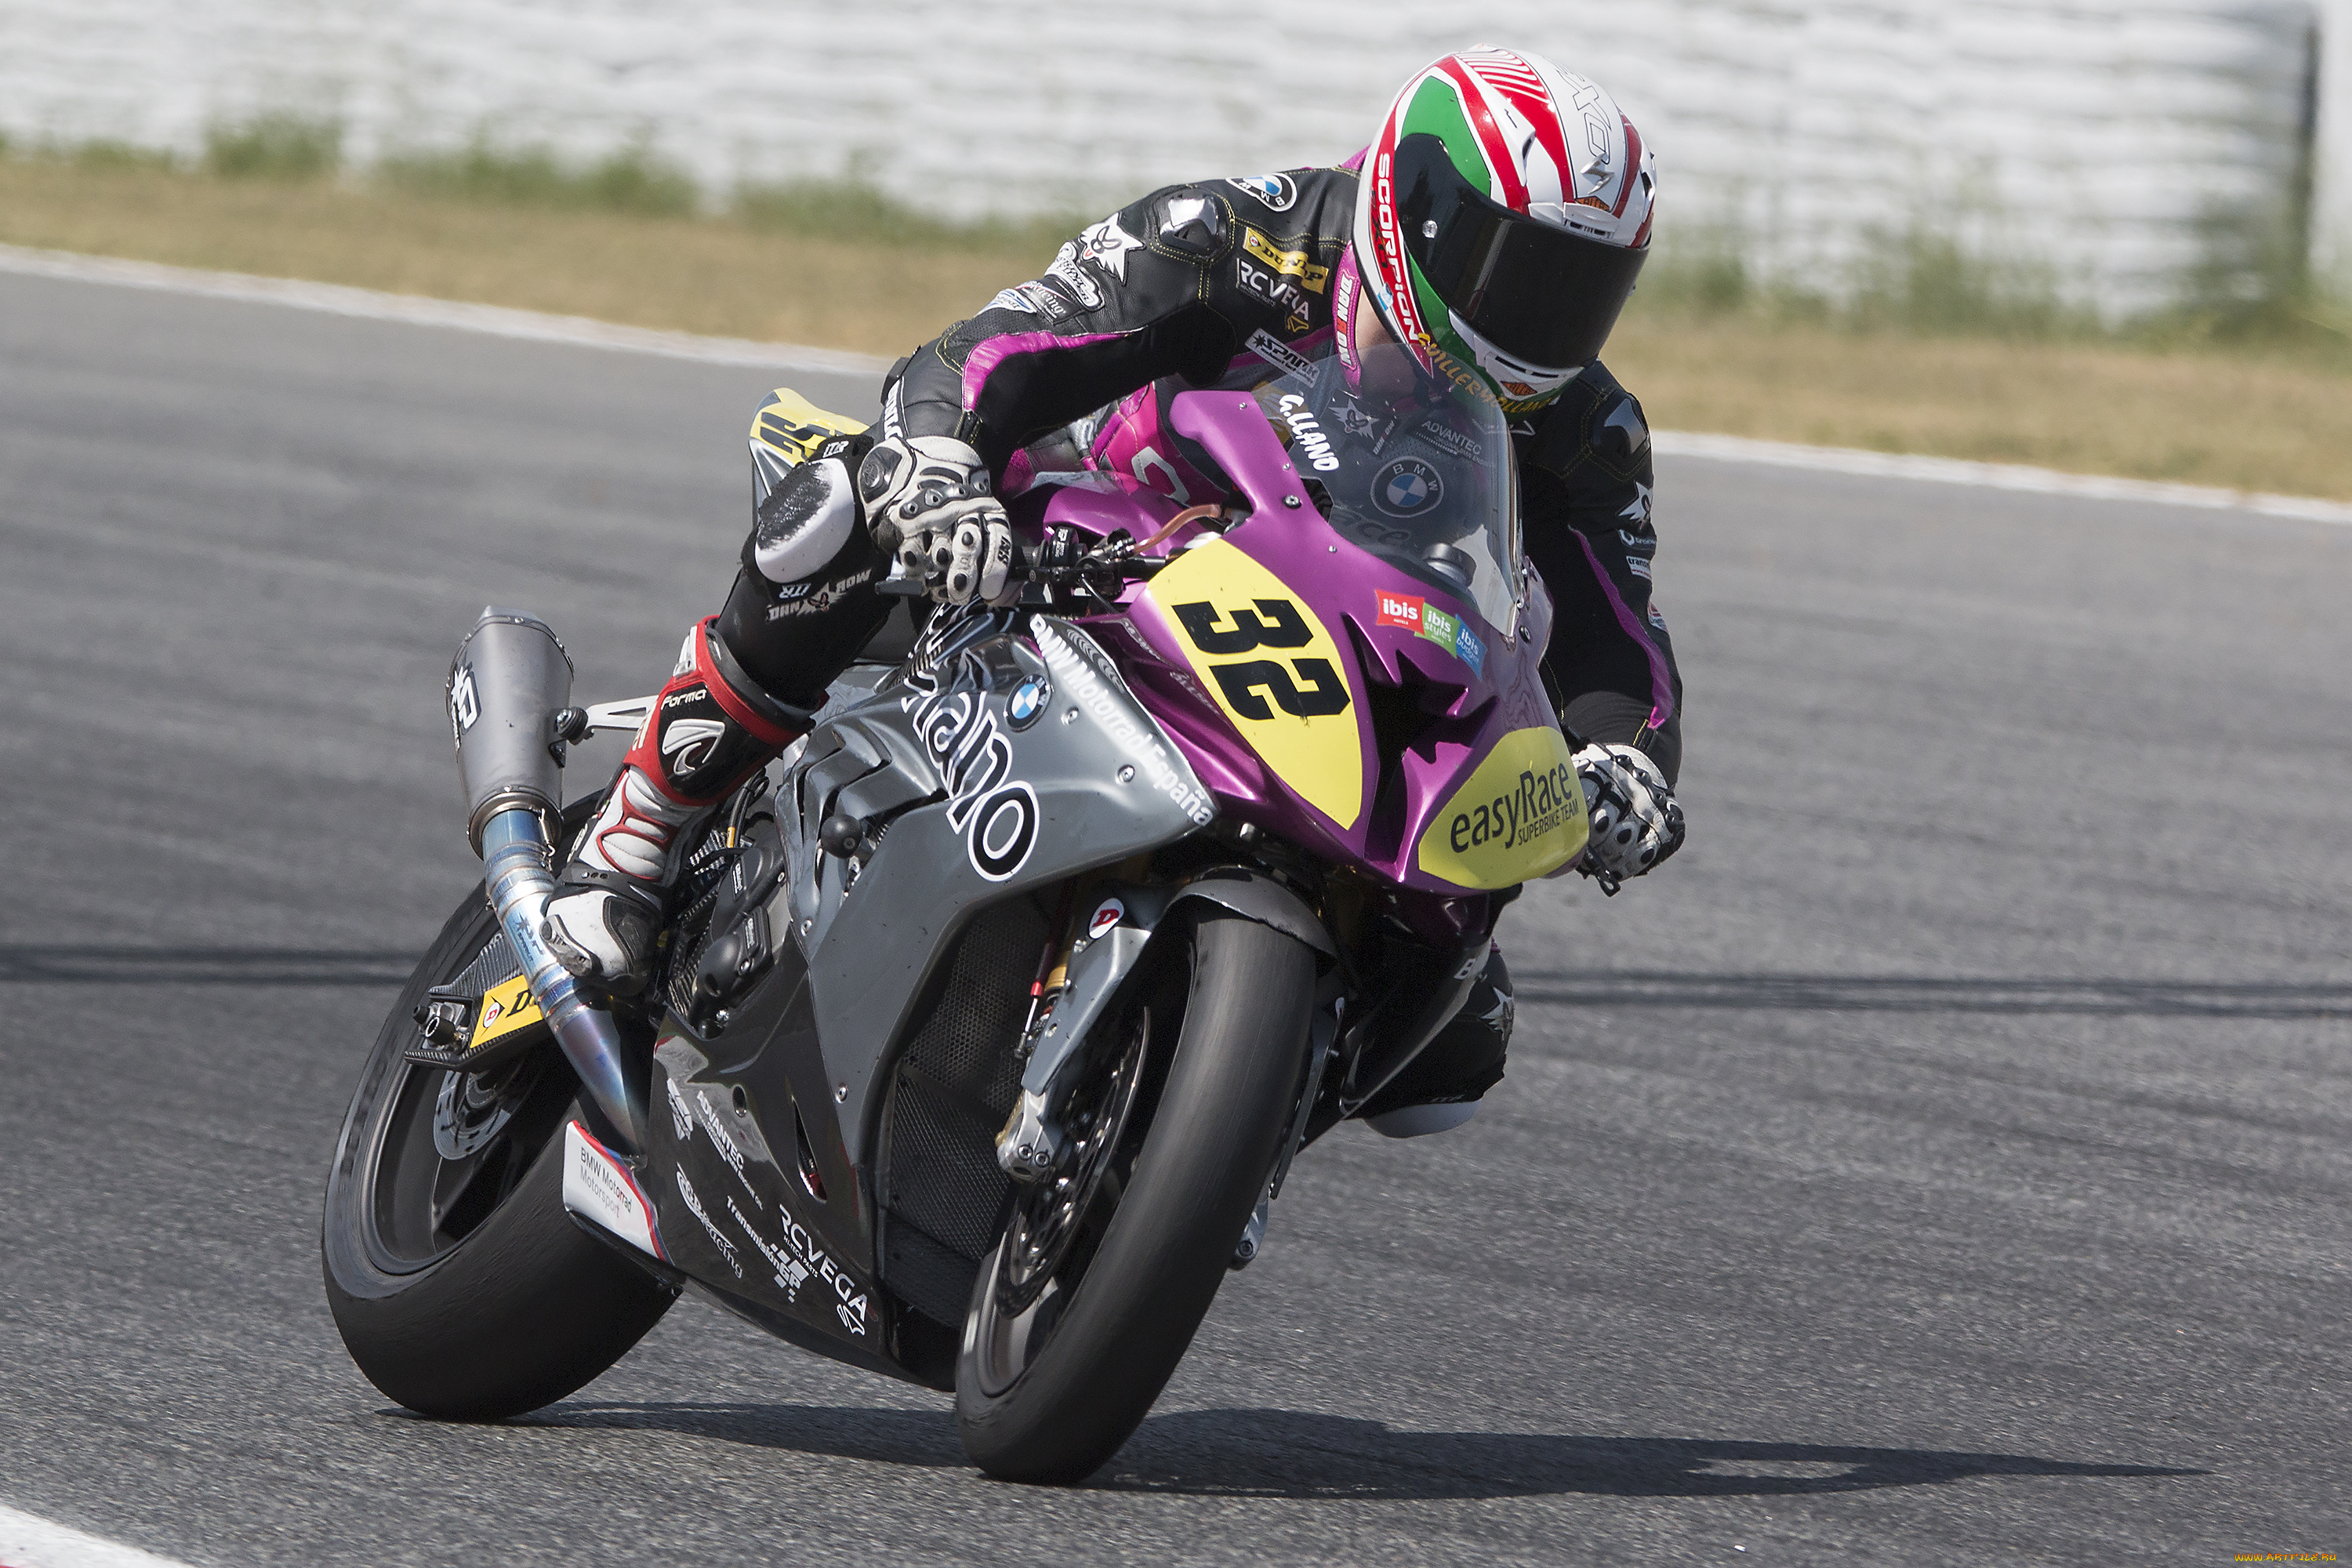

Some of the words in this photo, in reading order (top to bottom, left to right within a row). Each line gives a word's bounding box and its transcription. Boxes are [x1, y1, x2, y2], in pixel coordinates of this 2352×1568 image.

[1377, 152, 1418, 342] SCORPION
[1421, 420, 1482, 456] ADVANTEC
[1383, 598, 1418, 620] ibis
[1424, 622, 1451, 642] styles
[1428, 610, 1451, 633] ibis
[1171, 598, 1351, 720] 32
[1461, 628, 1479, 655] ibis
[1062, 666, 1157, 757] Motorrad
[1142, 743, 1214, 826] España
[1450, 763, 1572, 854] easyRace
[1518, 814, 1561, 846] SUPERBIKE
[1559, 798, 1580, 822] TEAM
[697, 1090, 744, 1171] ADVANTEC
[579, 1171, 621, 1218] Motorsport
[580, 1146, 601, 1178] BMW
[602, 1164, 633, 1213] Motorrad
[779, 1203, 868, 1321] RCVEGA
[783, 1234, 803, 1261] HI-TECH
[802, 1258, 819, 1279] PARTS
